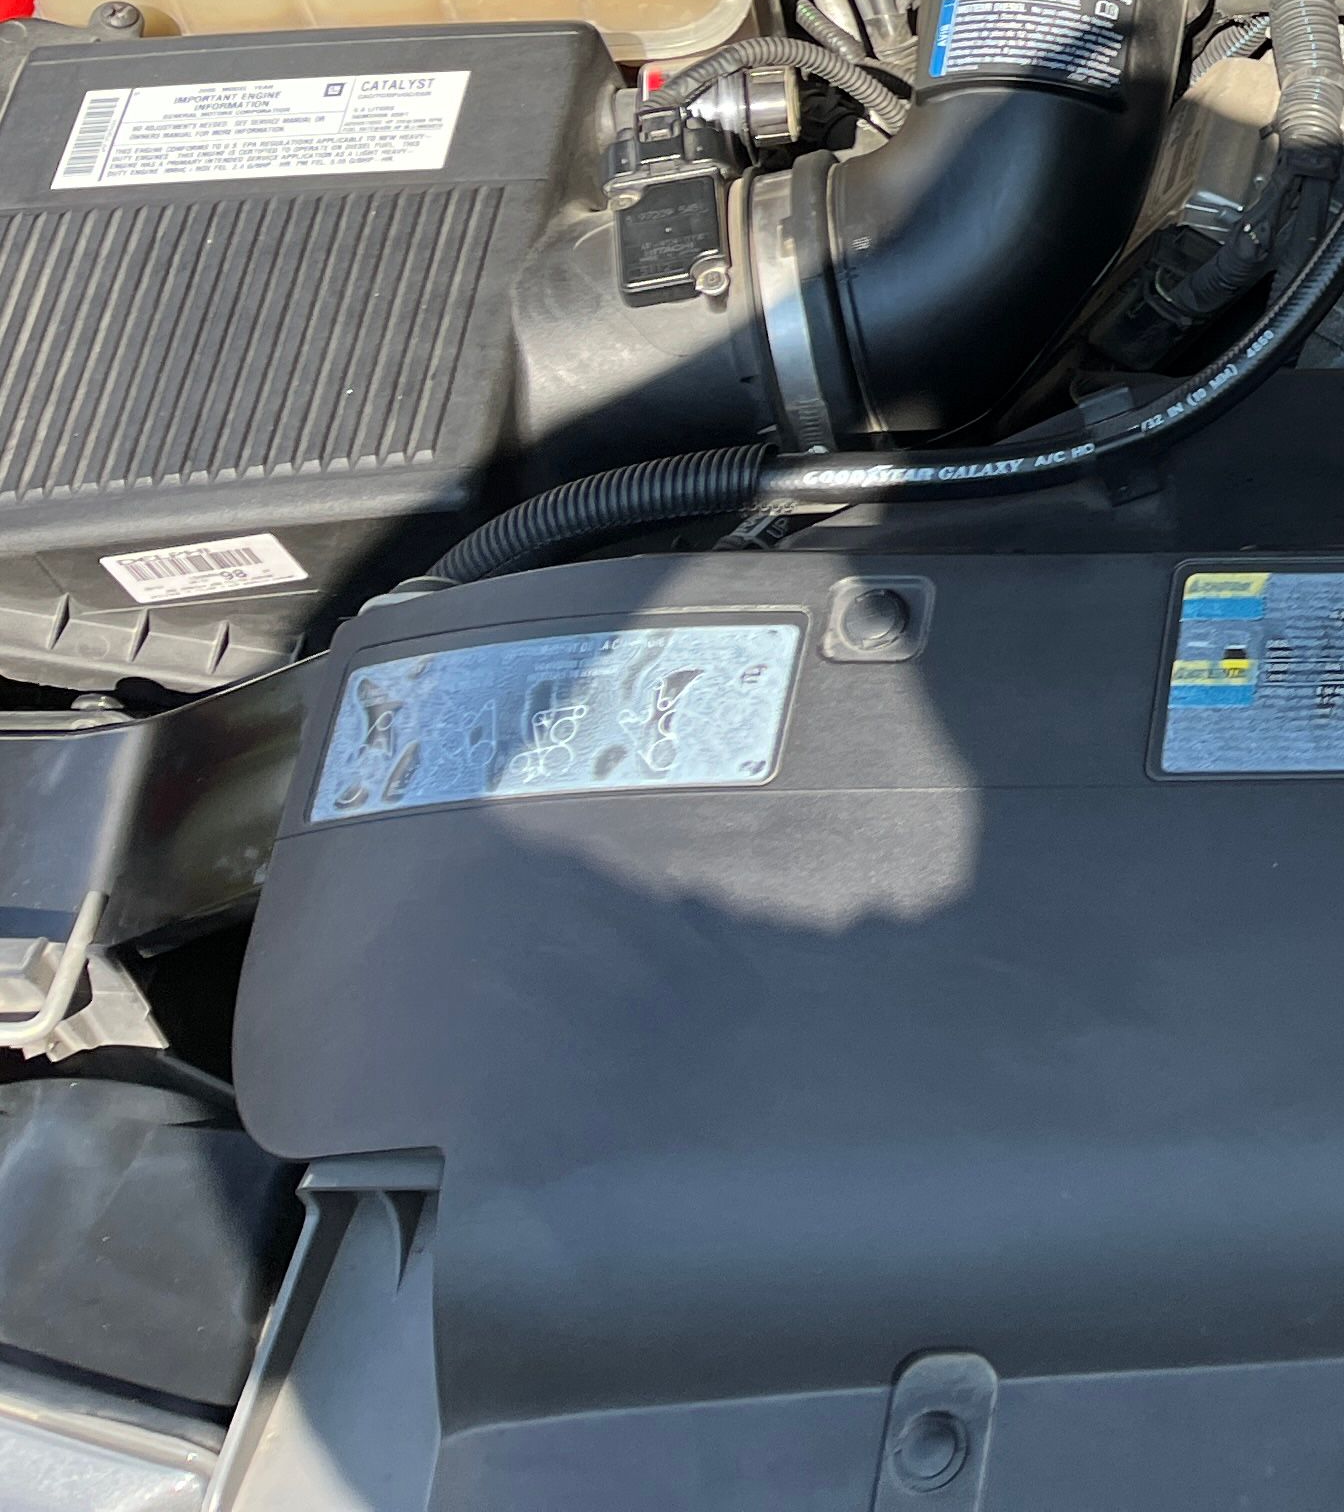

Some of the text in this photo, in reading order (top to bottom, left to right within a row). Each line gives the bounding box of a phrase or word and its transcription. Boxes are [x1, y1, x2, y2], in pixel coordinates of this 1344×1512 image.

[360, 78, 435, 92] CATALYST
[174, 91, 282, 105] IMPORTANT ENGINE
[194, 100, 270, 111] INFORMATION
[801, 464, 936, 487] GOODYEAR
[936, 457, 1025, 481] GALAXY
[1033, 451, 1067, 468] A/C
[220, 568, 247, 581] 98
